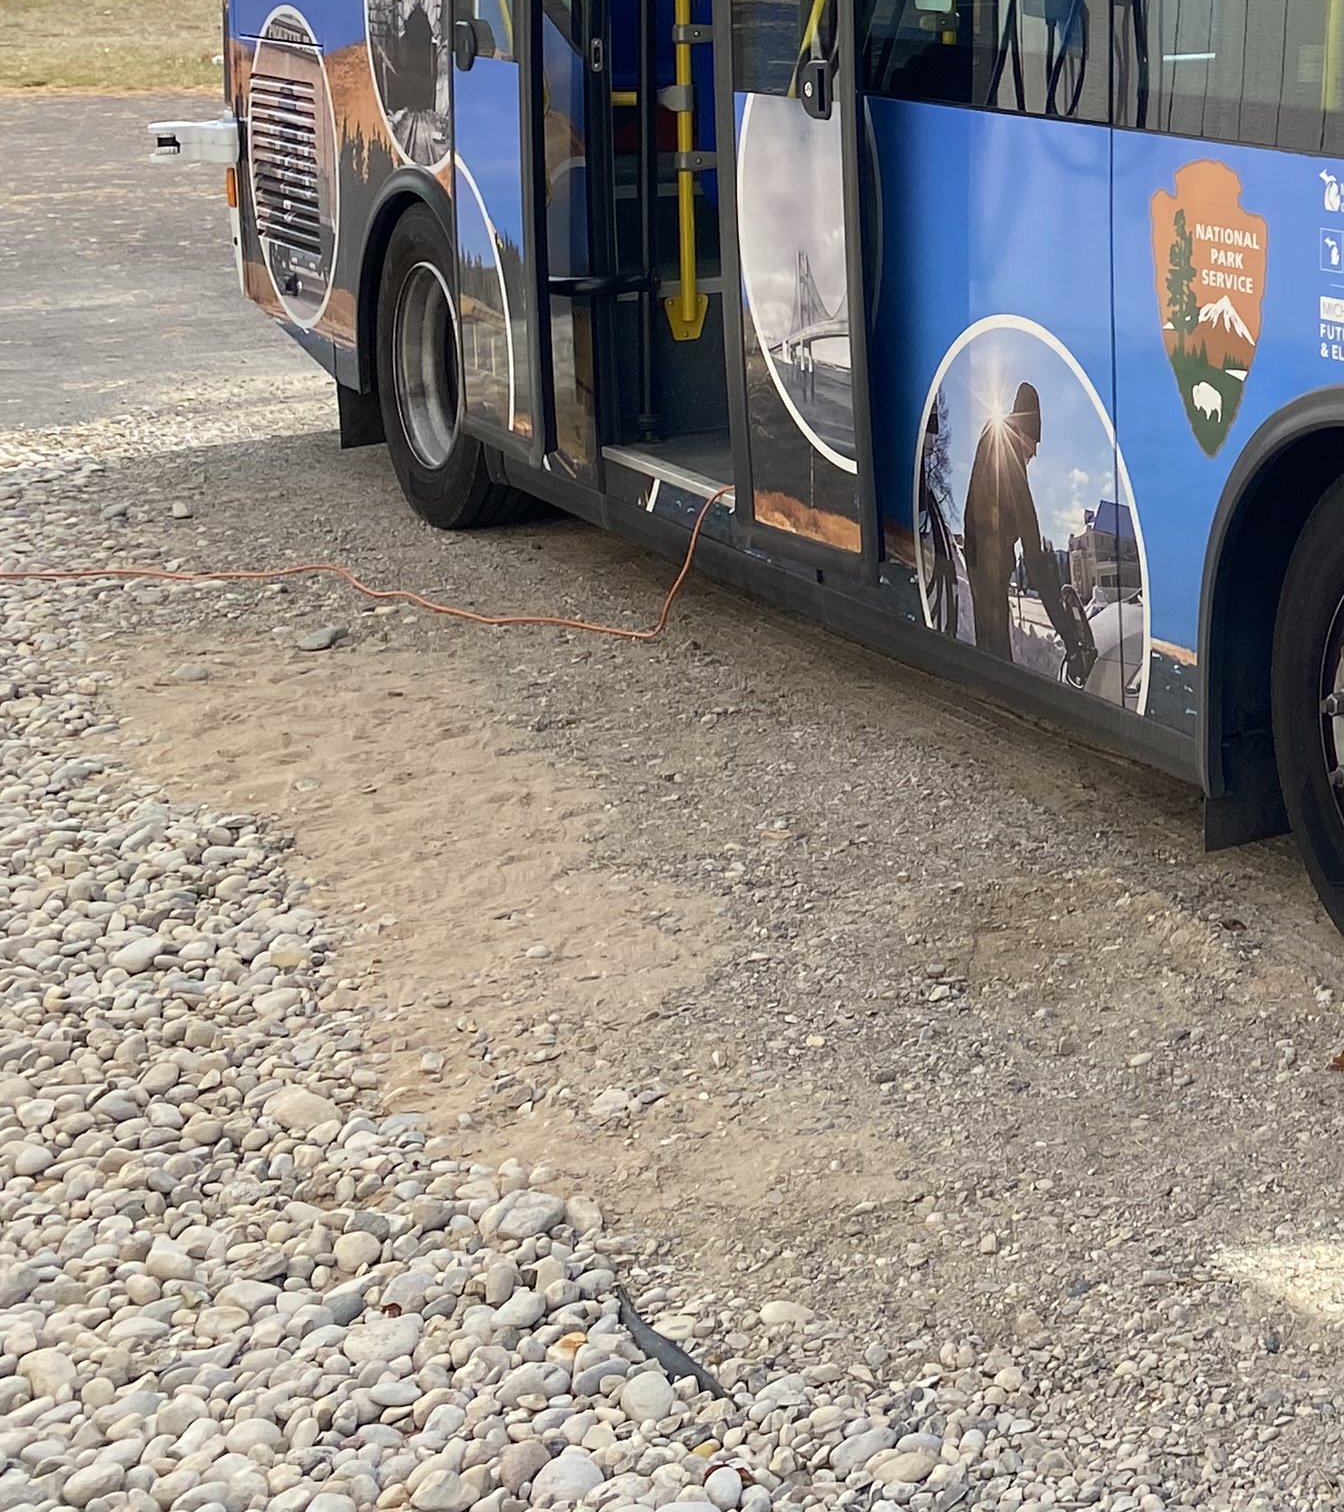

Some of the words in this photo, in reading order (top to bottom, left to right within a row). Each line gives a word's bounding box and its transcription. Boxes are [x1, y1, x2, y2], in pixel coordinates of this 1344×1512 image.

[1195, 223, 1260, 250] NATIONAL
[1210, 248, 1244, 269] PARK
[1201, 269, 1254, 294] SERVICE
[1320, 342, 1329, 358] &
